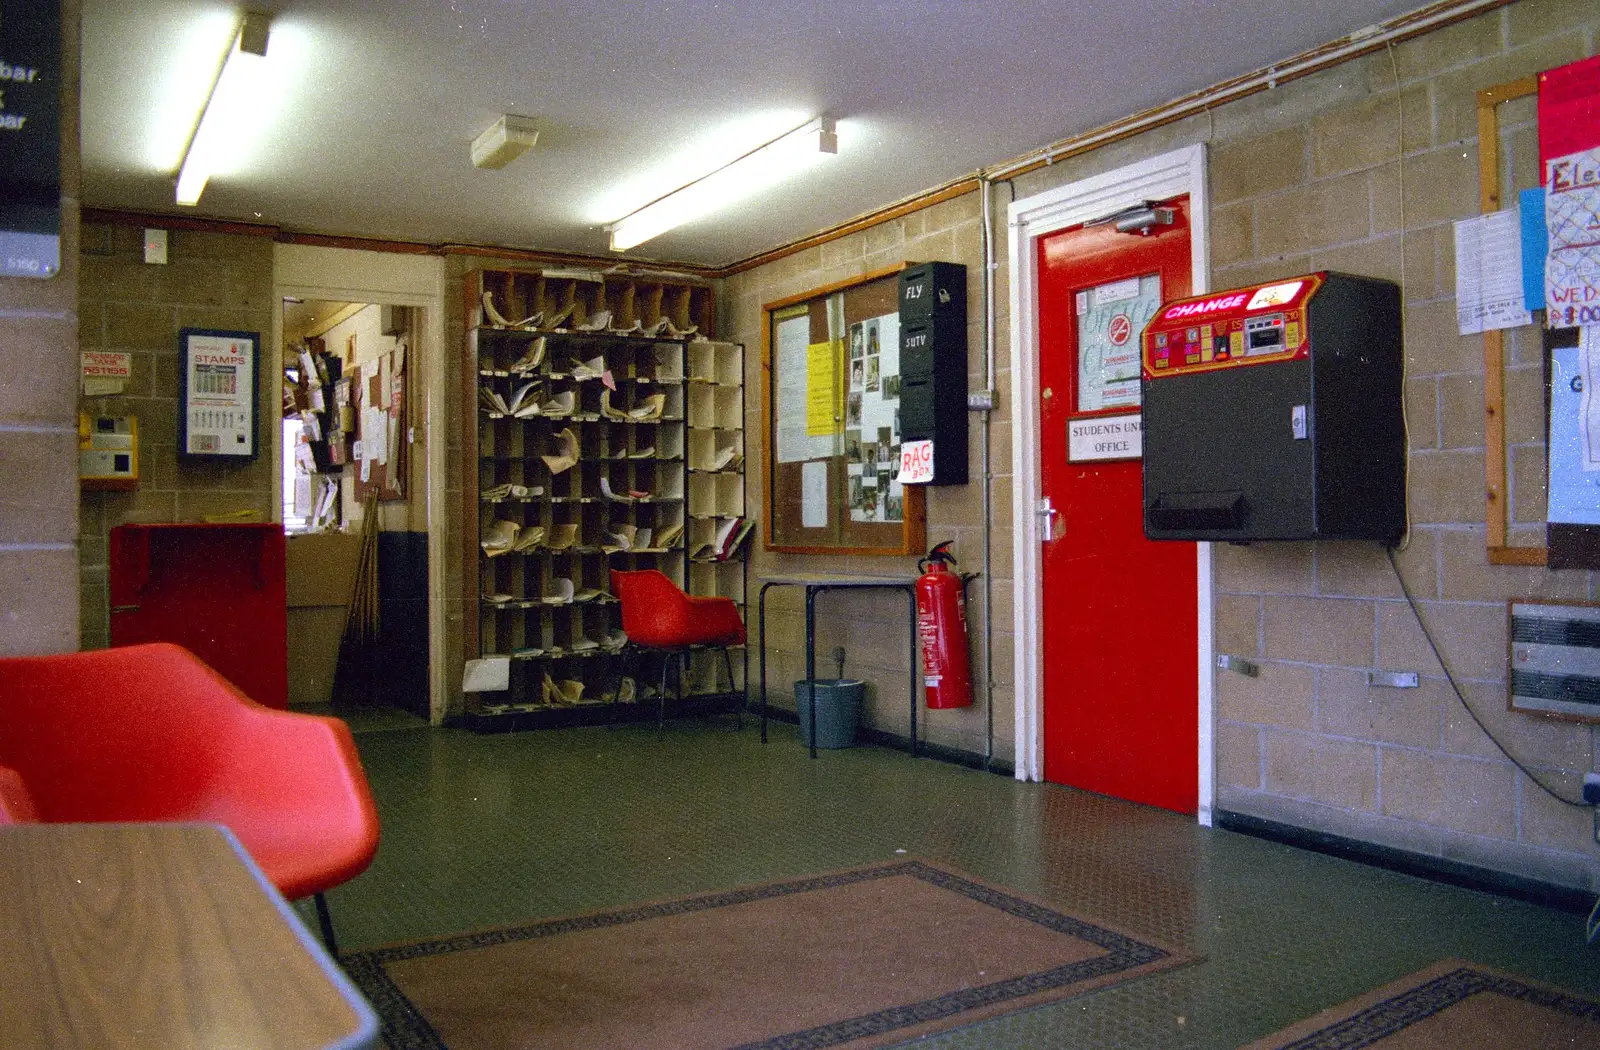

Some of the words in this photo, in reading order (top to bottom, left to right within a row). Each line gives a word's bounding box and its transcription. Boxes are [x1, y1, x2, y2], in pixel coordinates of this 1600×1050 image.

[1550, 161, 1600, 194] Ele
[906, 284, 923, 299] FLY
[1165, 294, 1247, 319] CHANGE
[905, 335, 927, 348] SUTV
[195, 354, 246, 366] STAMPS
[1073, 423, 1121, 437] STUDENTS
[1095, 441, 1129, 452] OFFICE
[903, 443, 931, 472] RAG
[912, 467, 930, 480] BOX
